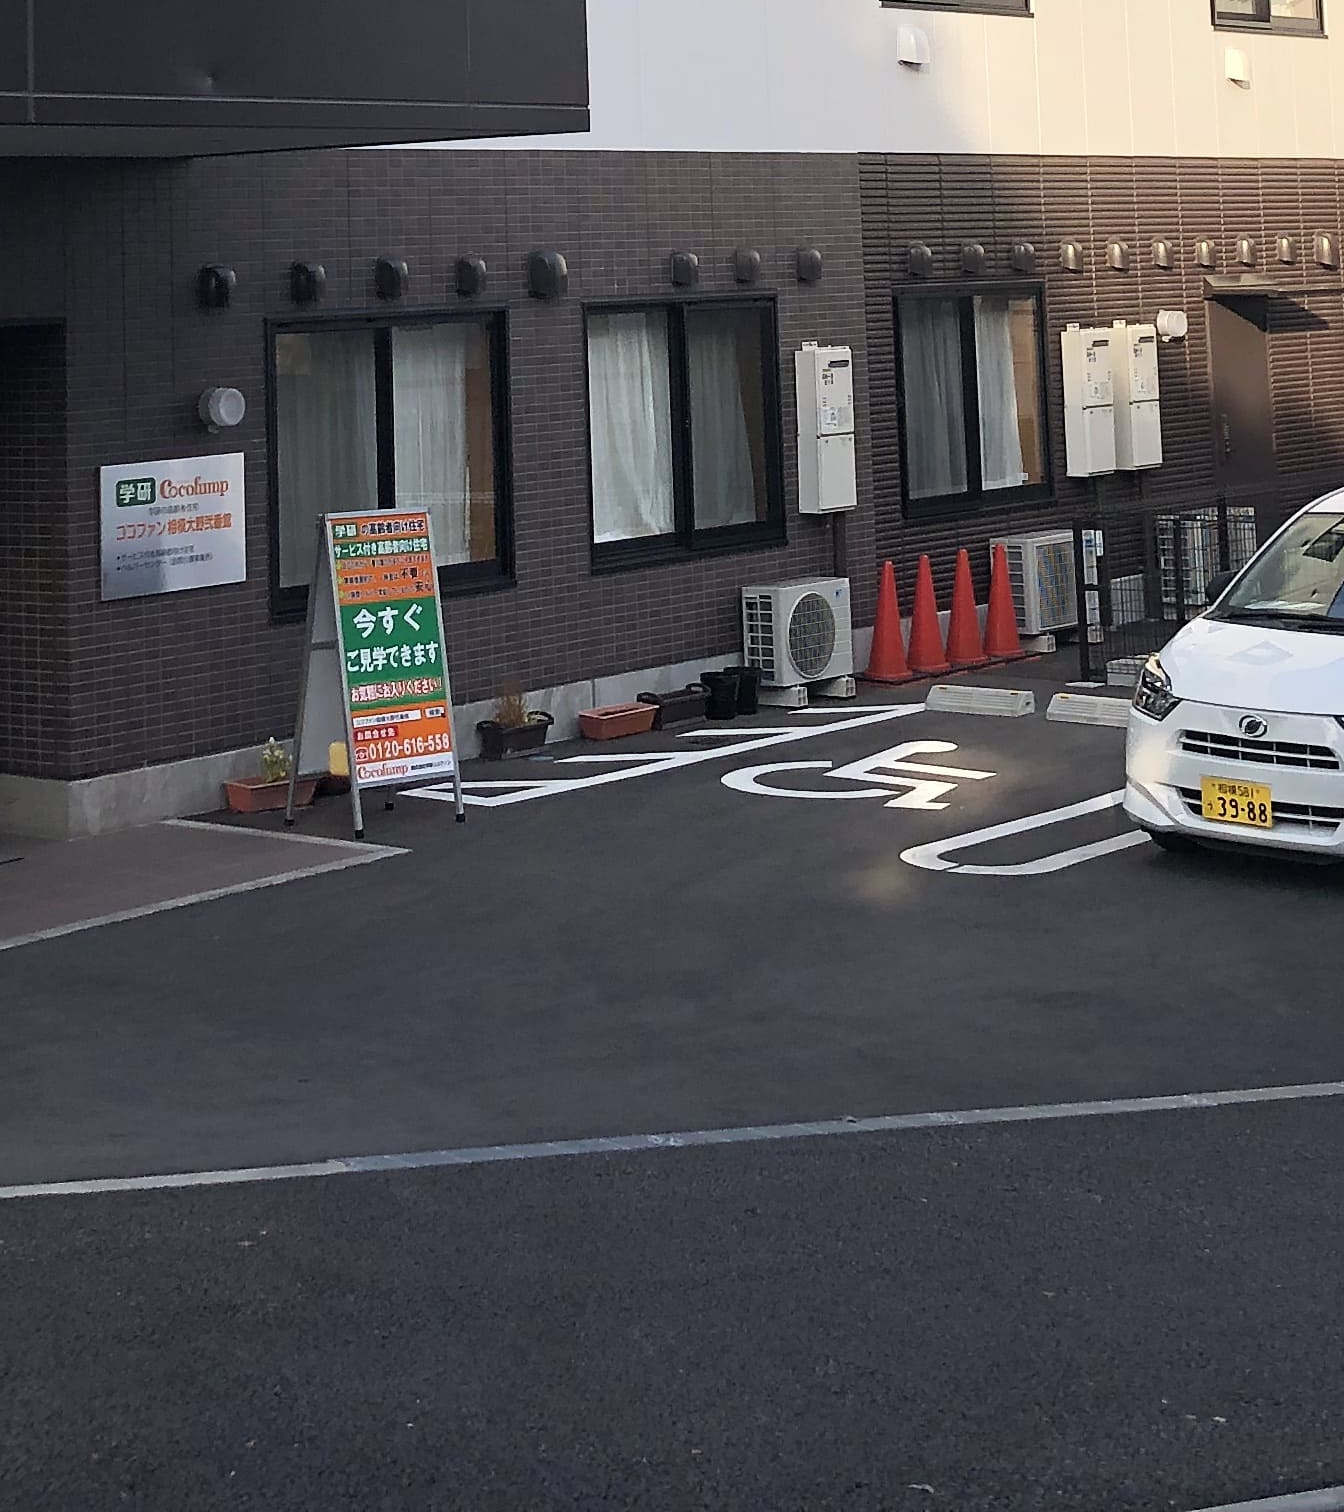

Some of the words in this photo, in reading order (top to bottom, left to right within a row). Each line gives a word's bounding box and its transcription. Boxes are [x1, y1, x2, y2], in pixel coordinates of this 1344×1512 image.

[119, 482, 152, 503] 学研
[353, 603, 423, 638] 今すぐ
[346, 640, 439, 673] ご見学できます
[369, 732, 450, 760] 0120-616-558
[1217, 796, 1268, 824] 39-88
